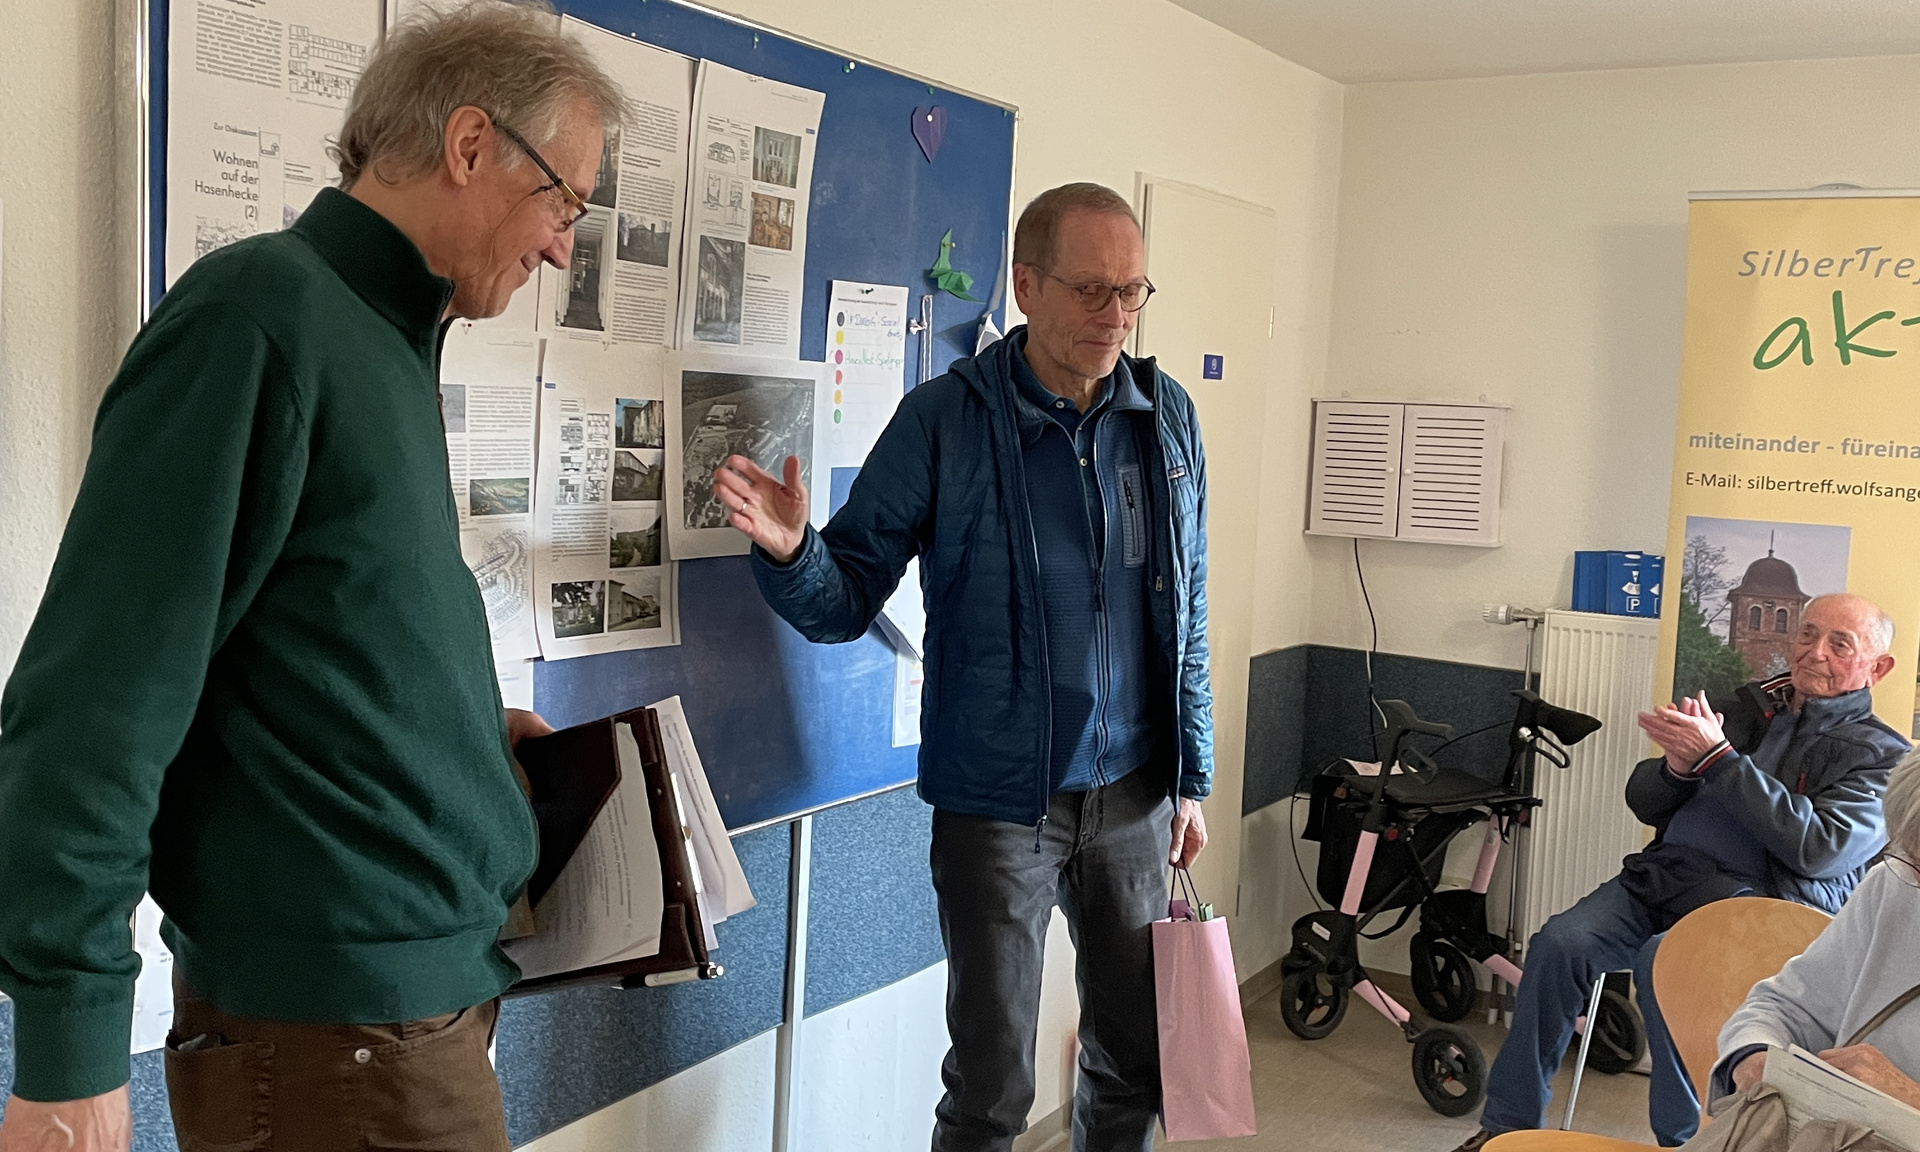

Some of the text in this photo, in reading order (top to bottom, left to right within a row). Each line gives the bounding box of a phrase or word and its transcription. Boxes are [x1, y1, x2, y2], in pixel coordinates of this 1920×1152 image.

[212, 148, 259, 168] Wohnen
[221, 169, 259, 185] auf der
[194, 180, 259, 201] Hasenhecke
[244, 205, 259, 220] (2)
[1738, 246, 1920, 285] SilberTre
[1753, 290, 1920, 370] ak
[1689, 432, 1820, 454] miteinander
[1686, 471, 1742, 489] E-Mail:
[1630, 598, 1640, 611] P
